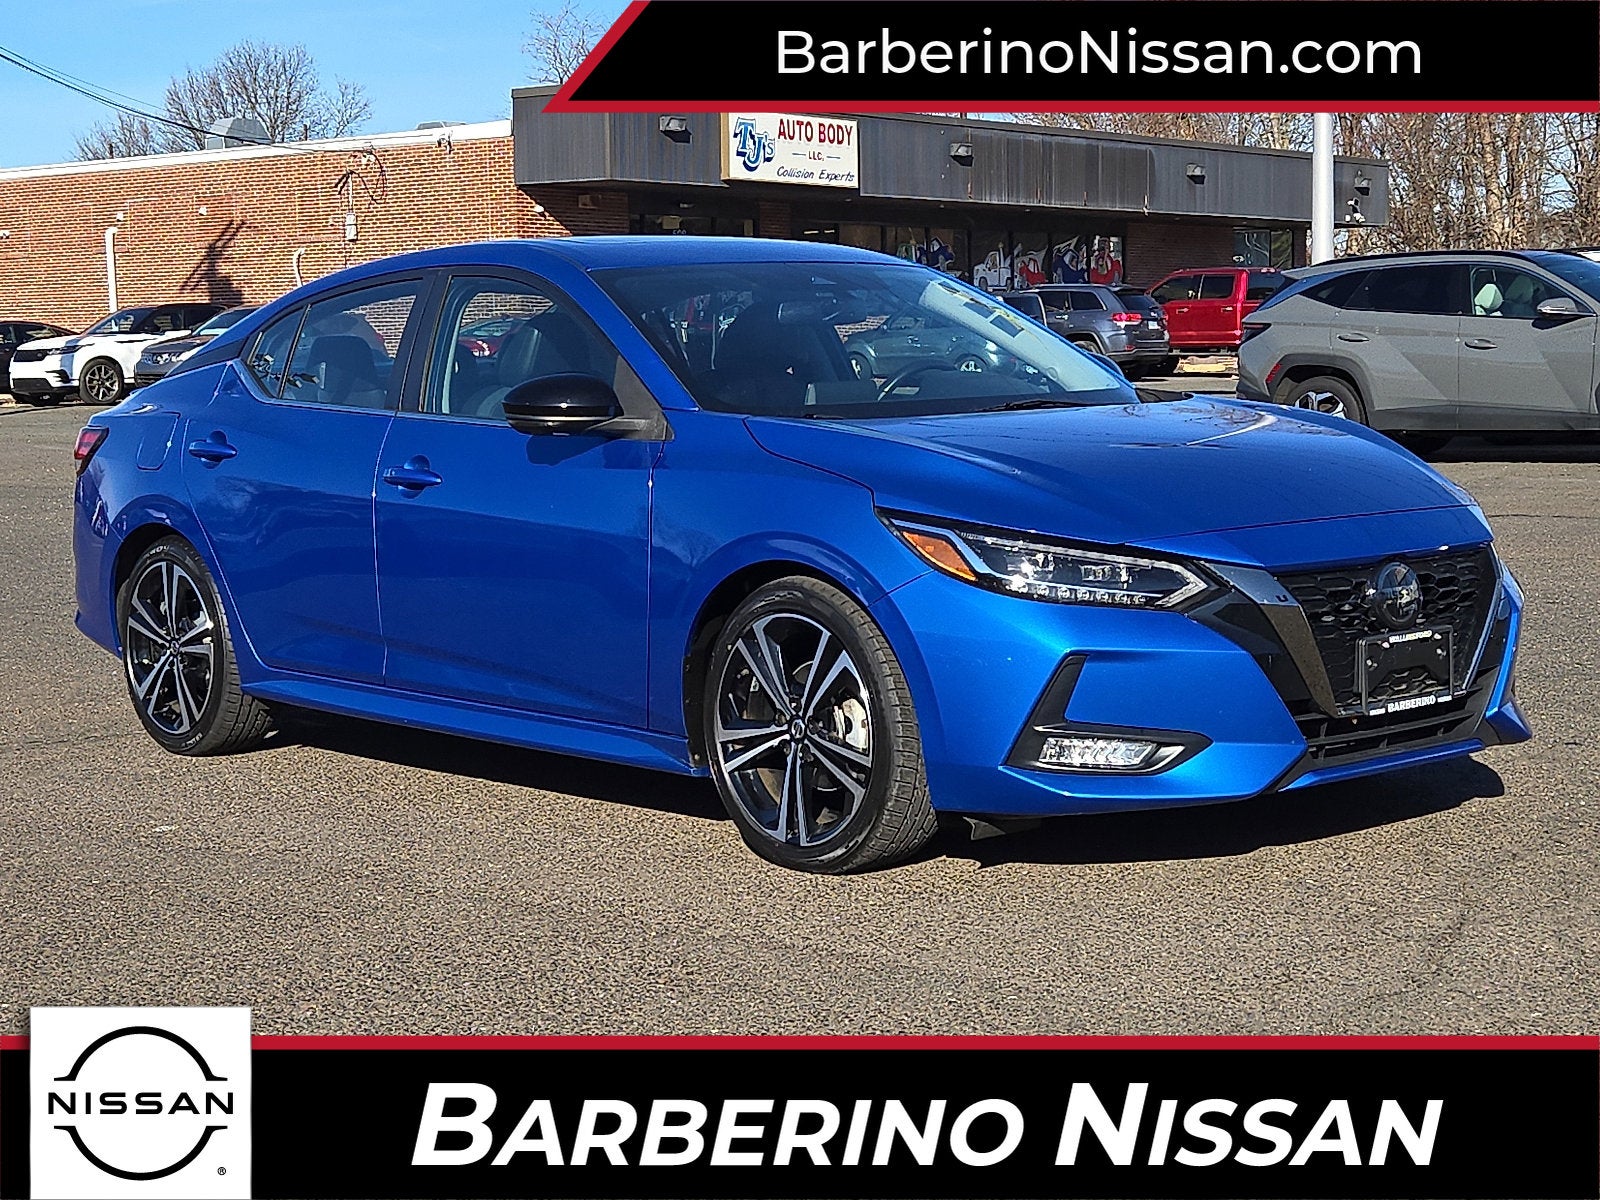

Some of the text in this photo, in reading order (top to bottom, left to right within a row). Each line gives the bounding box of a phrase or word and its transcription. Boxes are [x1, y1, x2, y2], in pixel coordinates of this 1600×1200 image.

[778, 118, 853, 146] AUTO BODY
[777, 165, 855, 182] Collision Experts
[1387, 695, 1437, 713] BARBERINO
